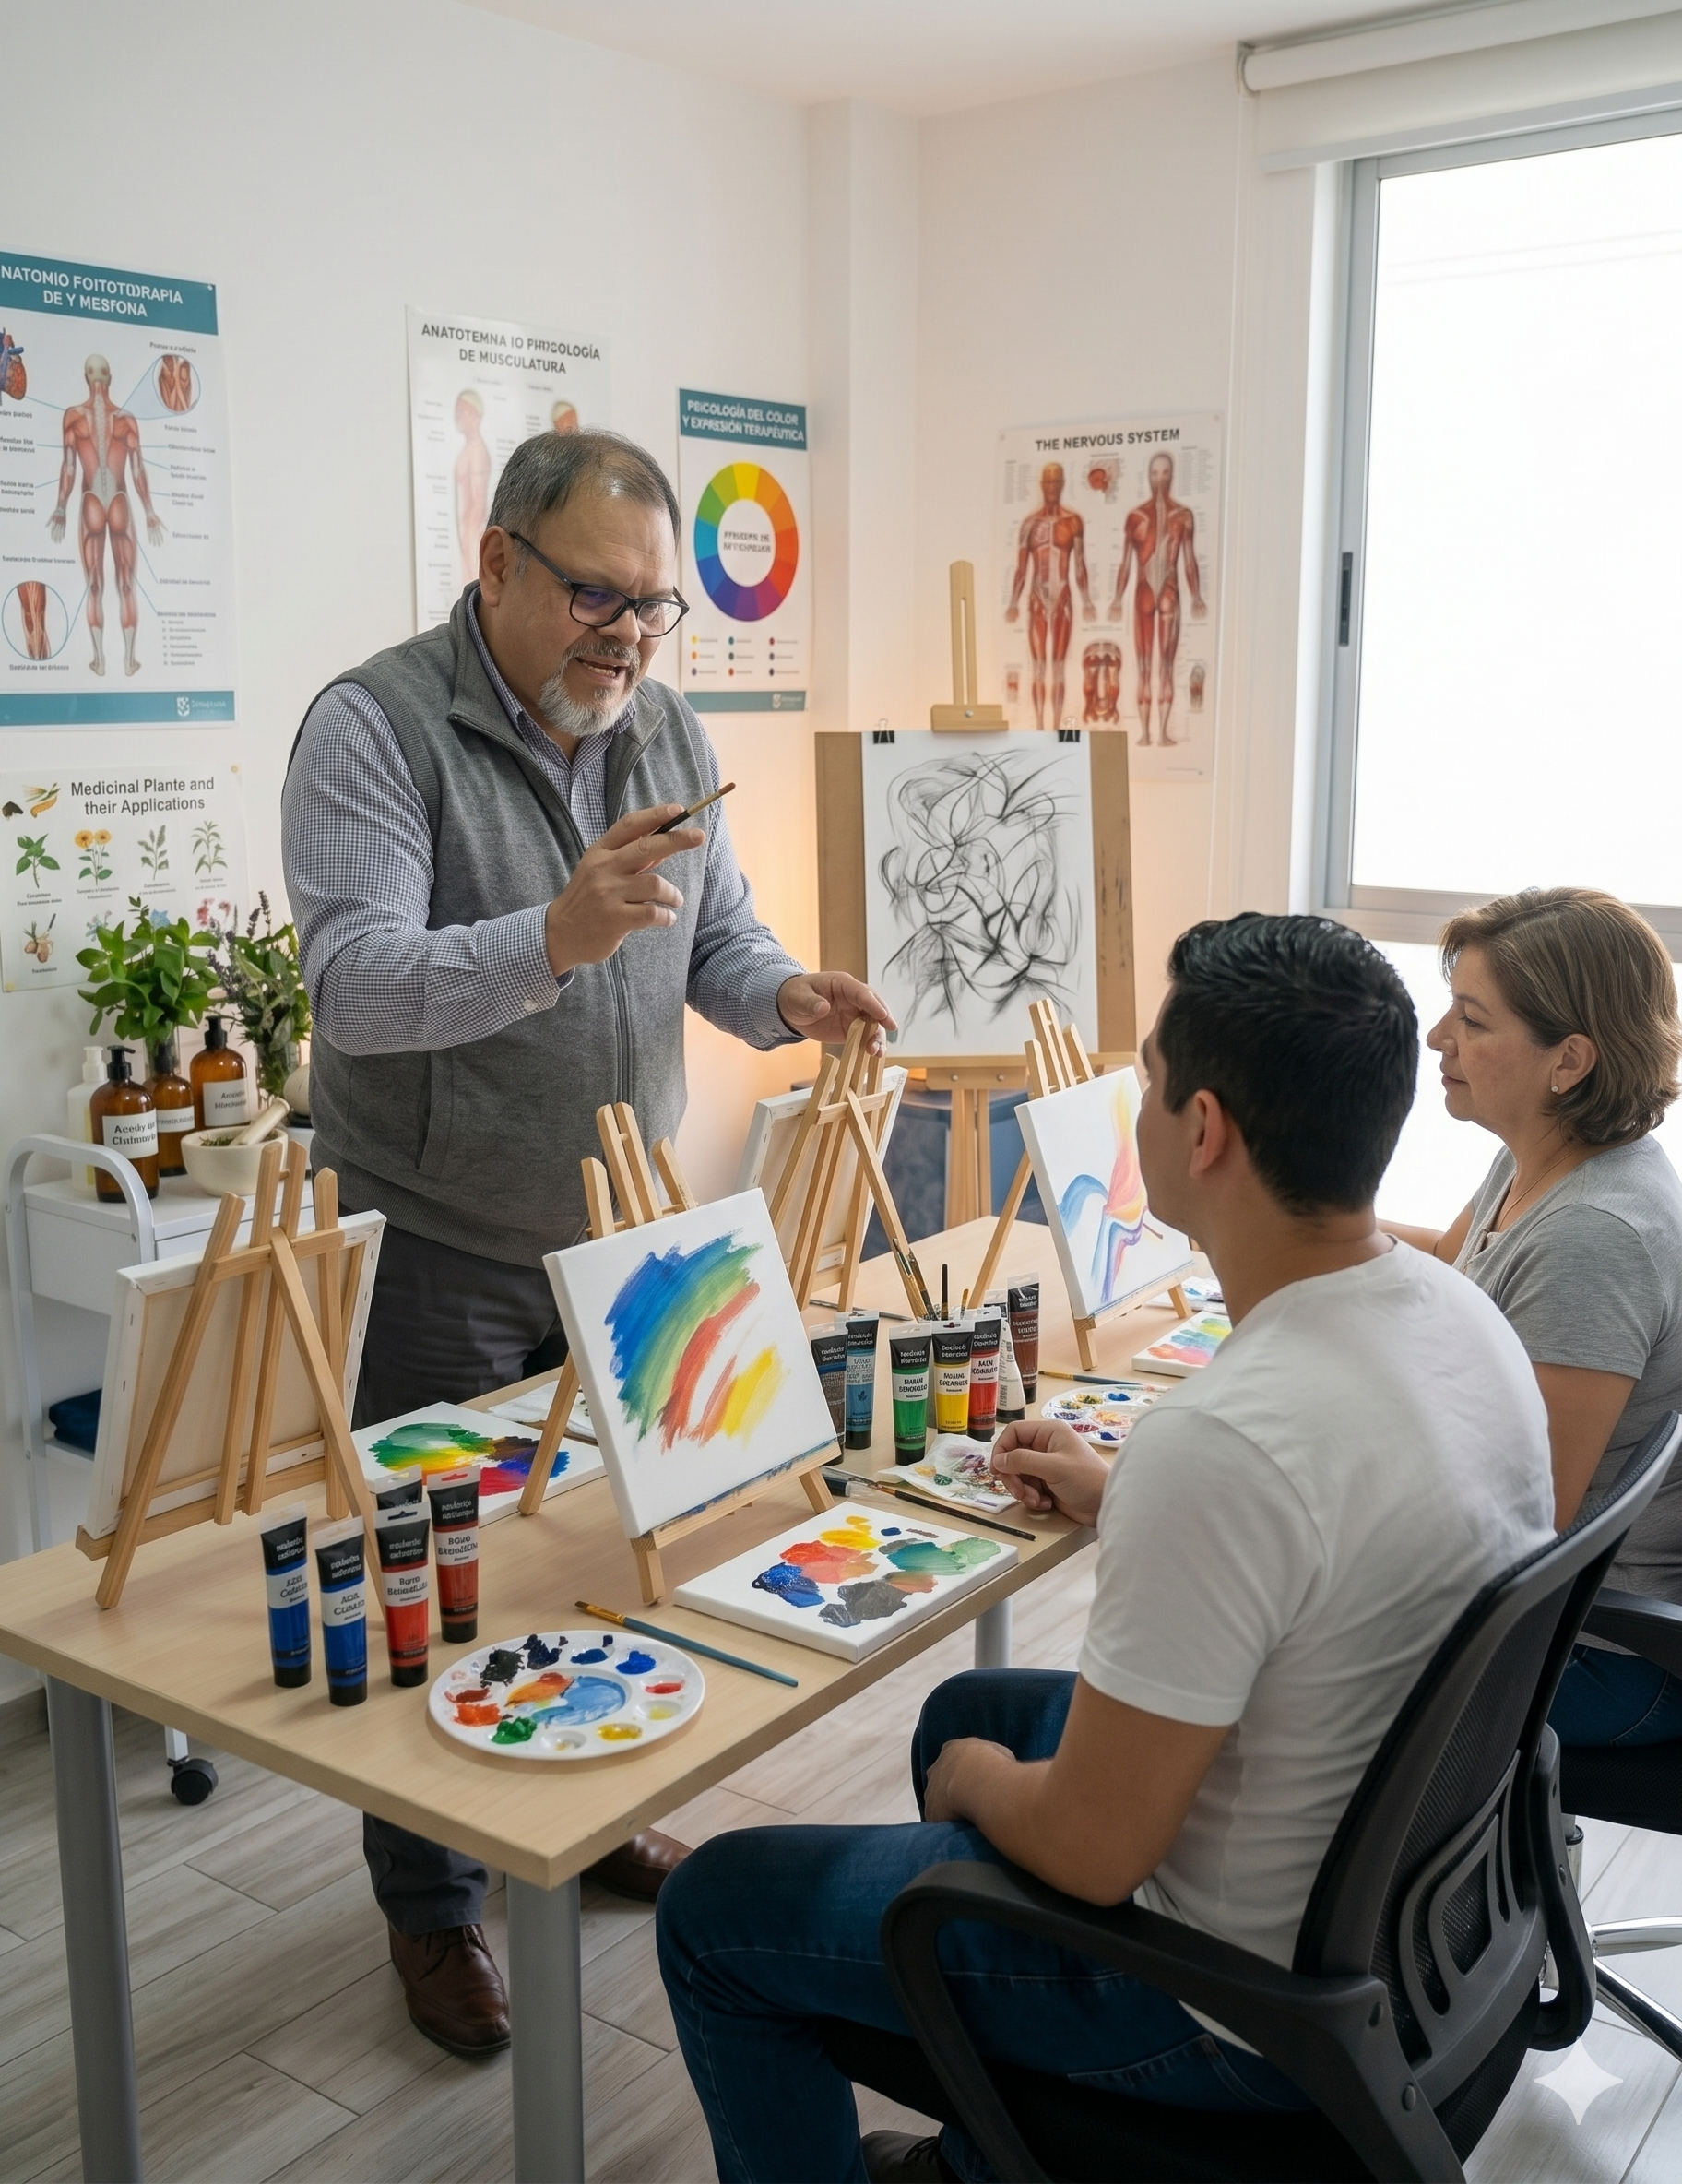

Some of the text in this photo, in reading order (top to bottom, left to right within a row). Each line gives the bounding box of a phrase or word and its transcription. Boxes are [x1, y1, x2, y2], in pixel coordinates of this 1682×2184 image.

[43, 290, 148, 317] DE Y MESFONA
[421, 324, 507, 348] ANATOTEMNA
[459, 349, 566, 374] DE MUSCULATURA
[682, 415, 690, 427] Y
[743, 422, 804, 441] TERAPÉUTICA
[747, 408, 764, 421] DEL
[766, 410, 799, 425] COLOR
[1036, 428, 1179, 452] THE NERVOUS SYSTEM
[71, 777, 215, 796] Medicinal Plante and
[85, 797, 206, 816] their Applications
